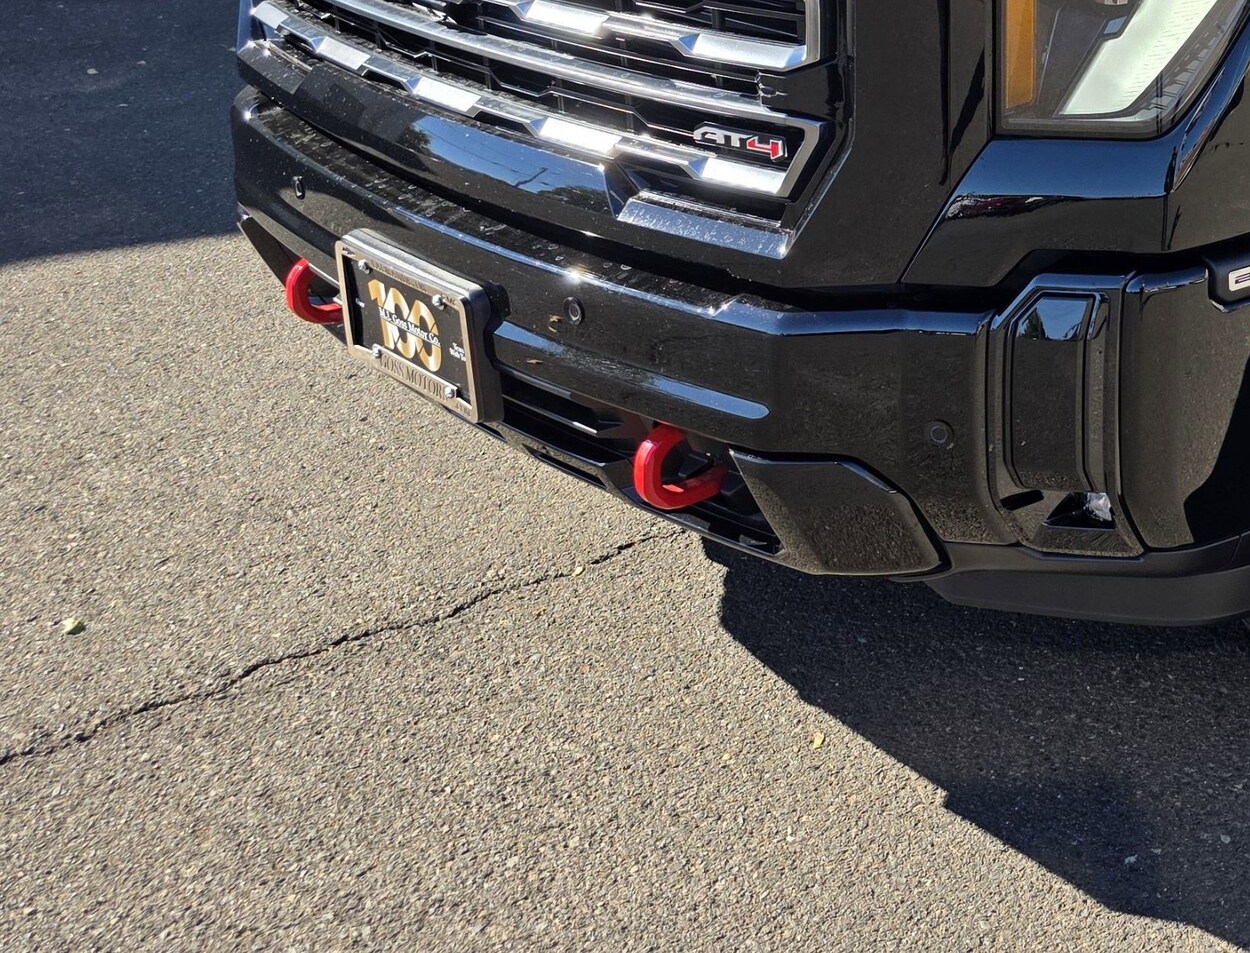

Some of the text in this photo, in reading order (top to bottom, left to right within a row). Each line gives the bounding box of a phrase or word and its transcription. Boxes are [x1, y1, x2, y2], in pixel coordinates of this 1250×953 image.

[693, 124, 785, 160] AT4
[367, 279, 442, 372] 100
[379, 353, 405, 377] GOSS
